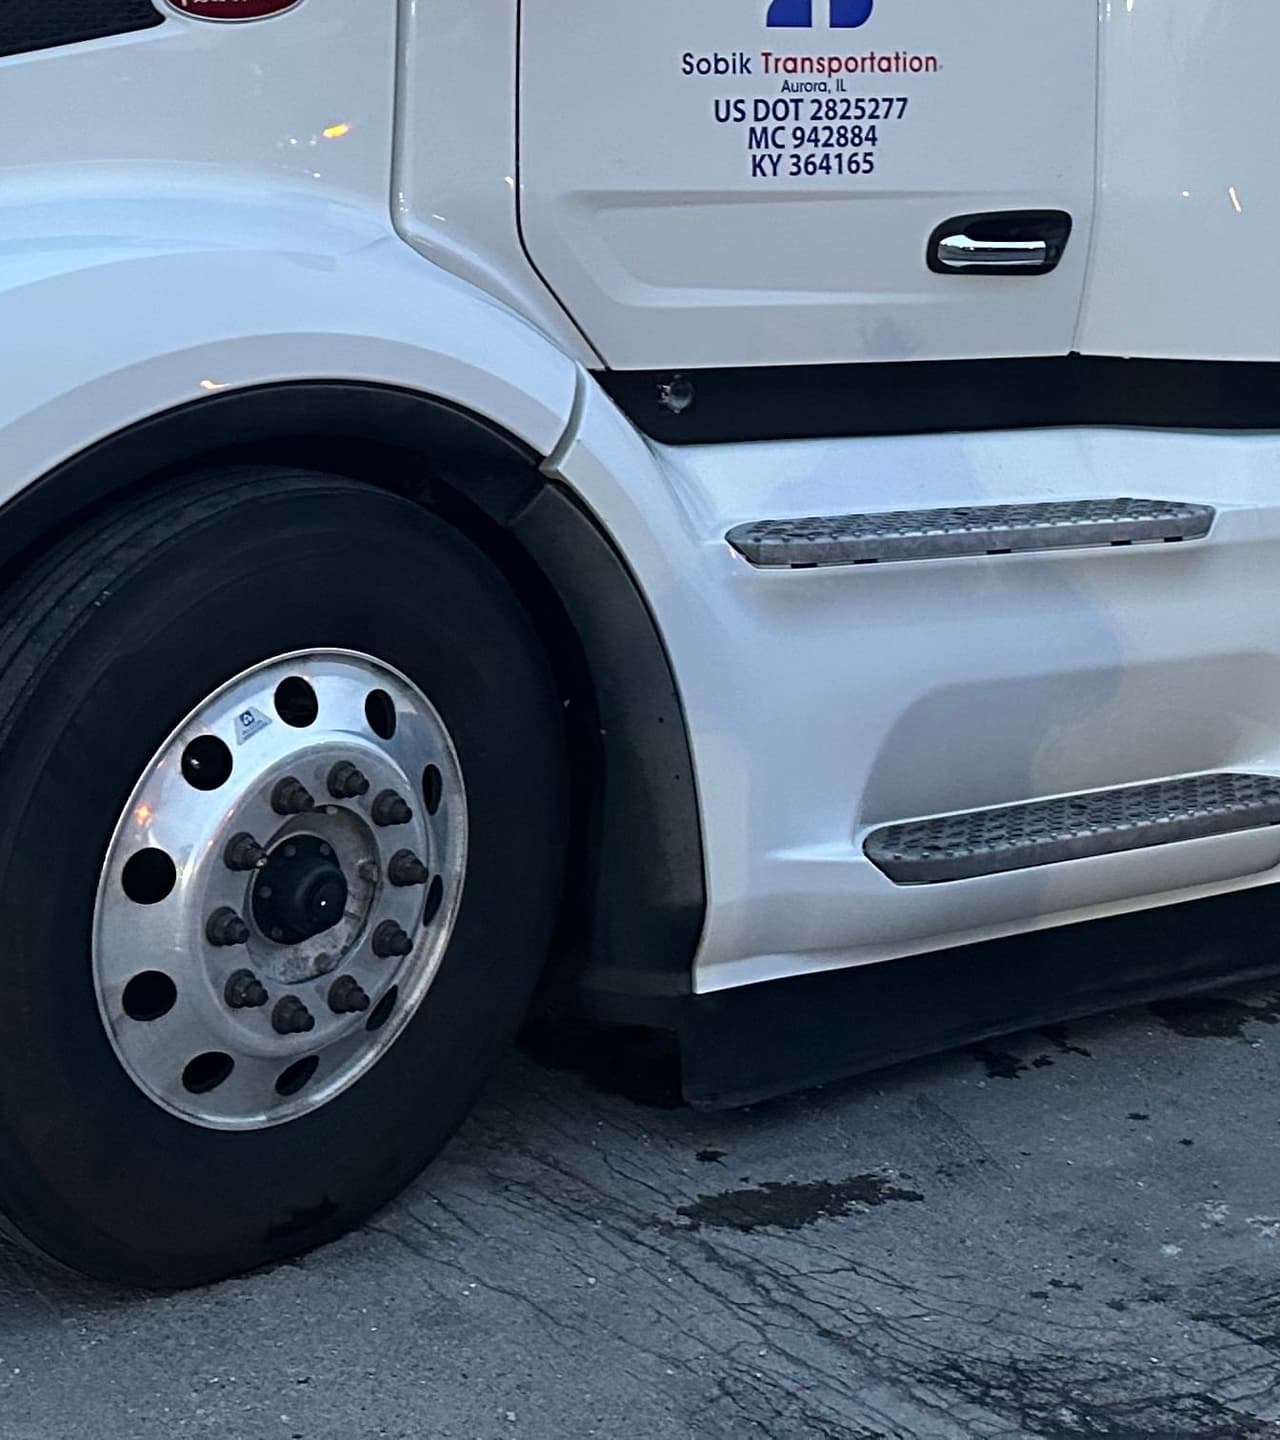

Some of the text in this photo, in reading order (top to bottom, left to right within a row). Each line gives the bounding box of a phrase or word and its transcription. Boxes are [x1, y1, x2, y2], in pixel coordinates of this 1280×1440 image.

[682, 51, 938, 78] Sobik Transportation
[781, 78, 846, 94] Aurora, IL
[714, 97, 908, 123] US DOT 2825277
[748, 125, 878, 150] MC 942884
[752, 152, 874, 177] KY 364165
